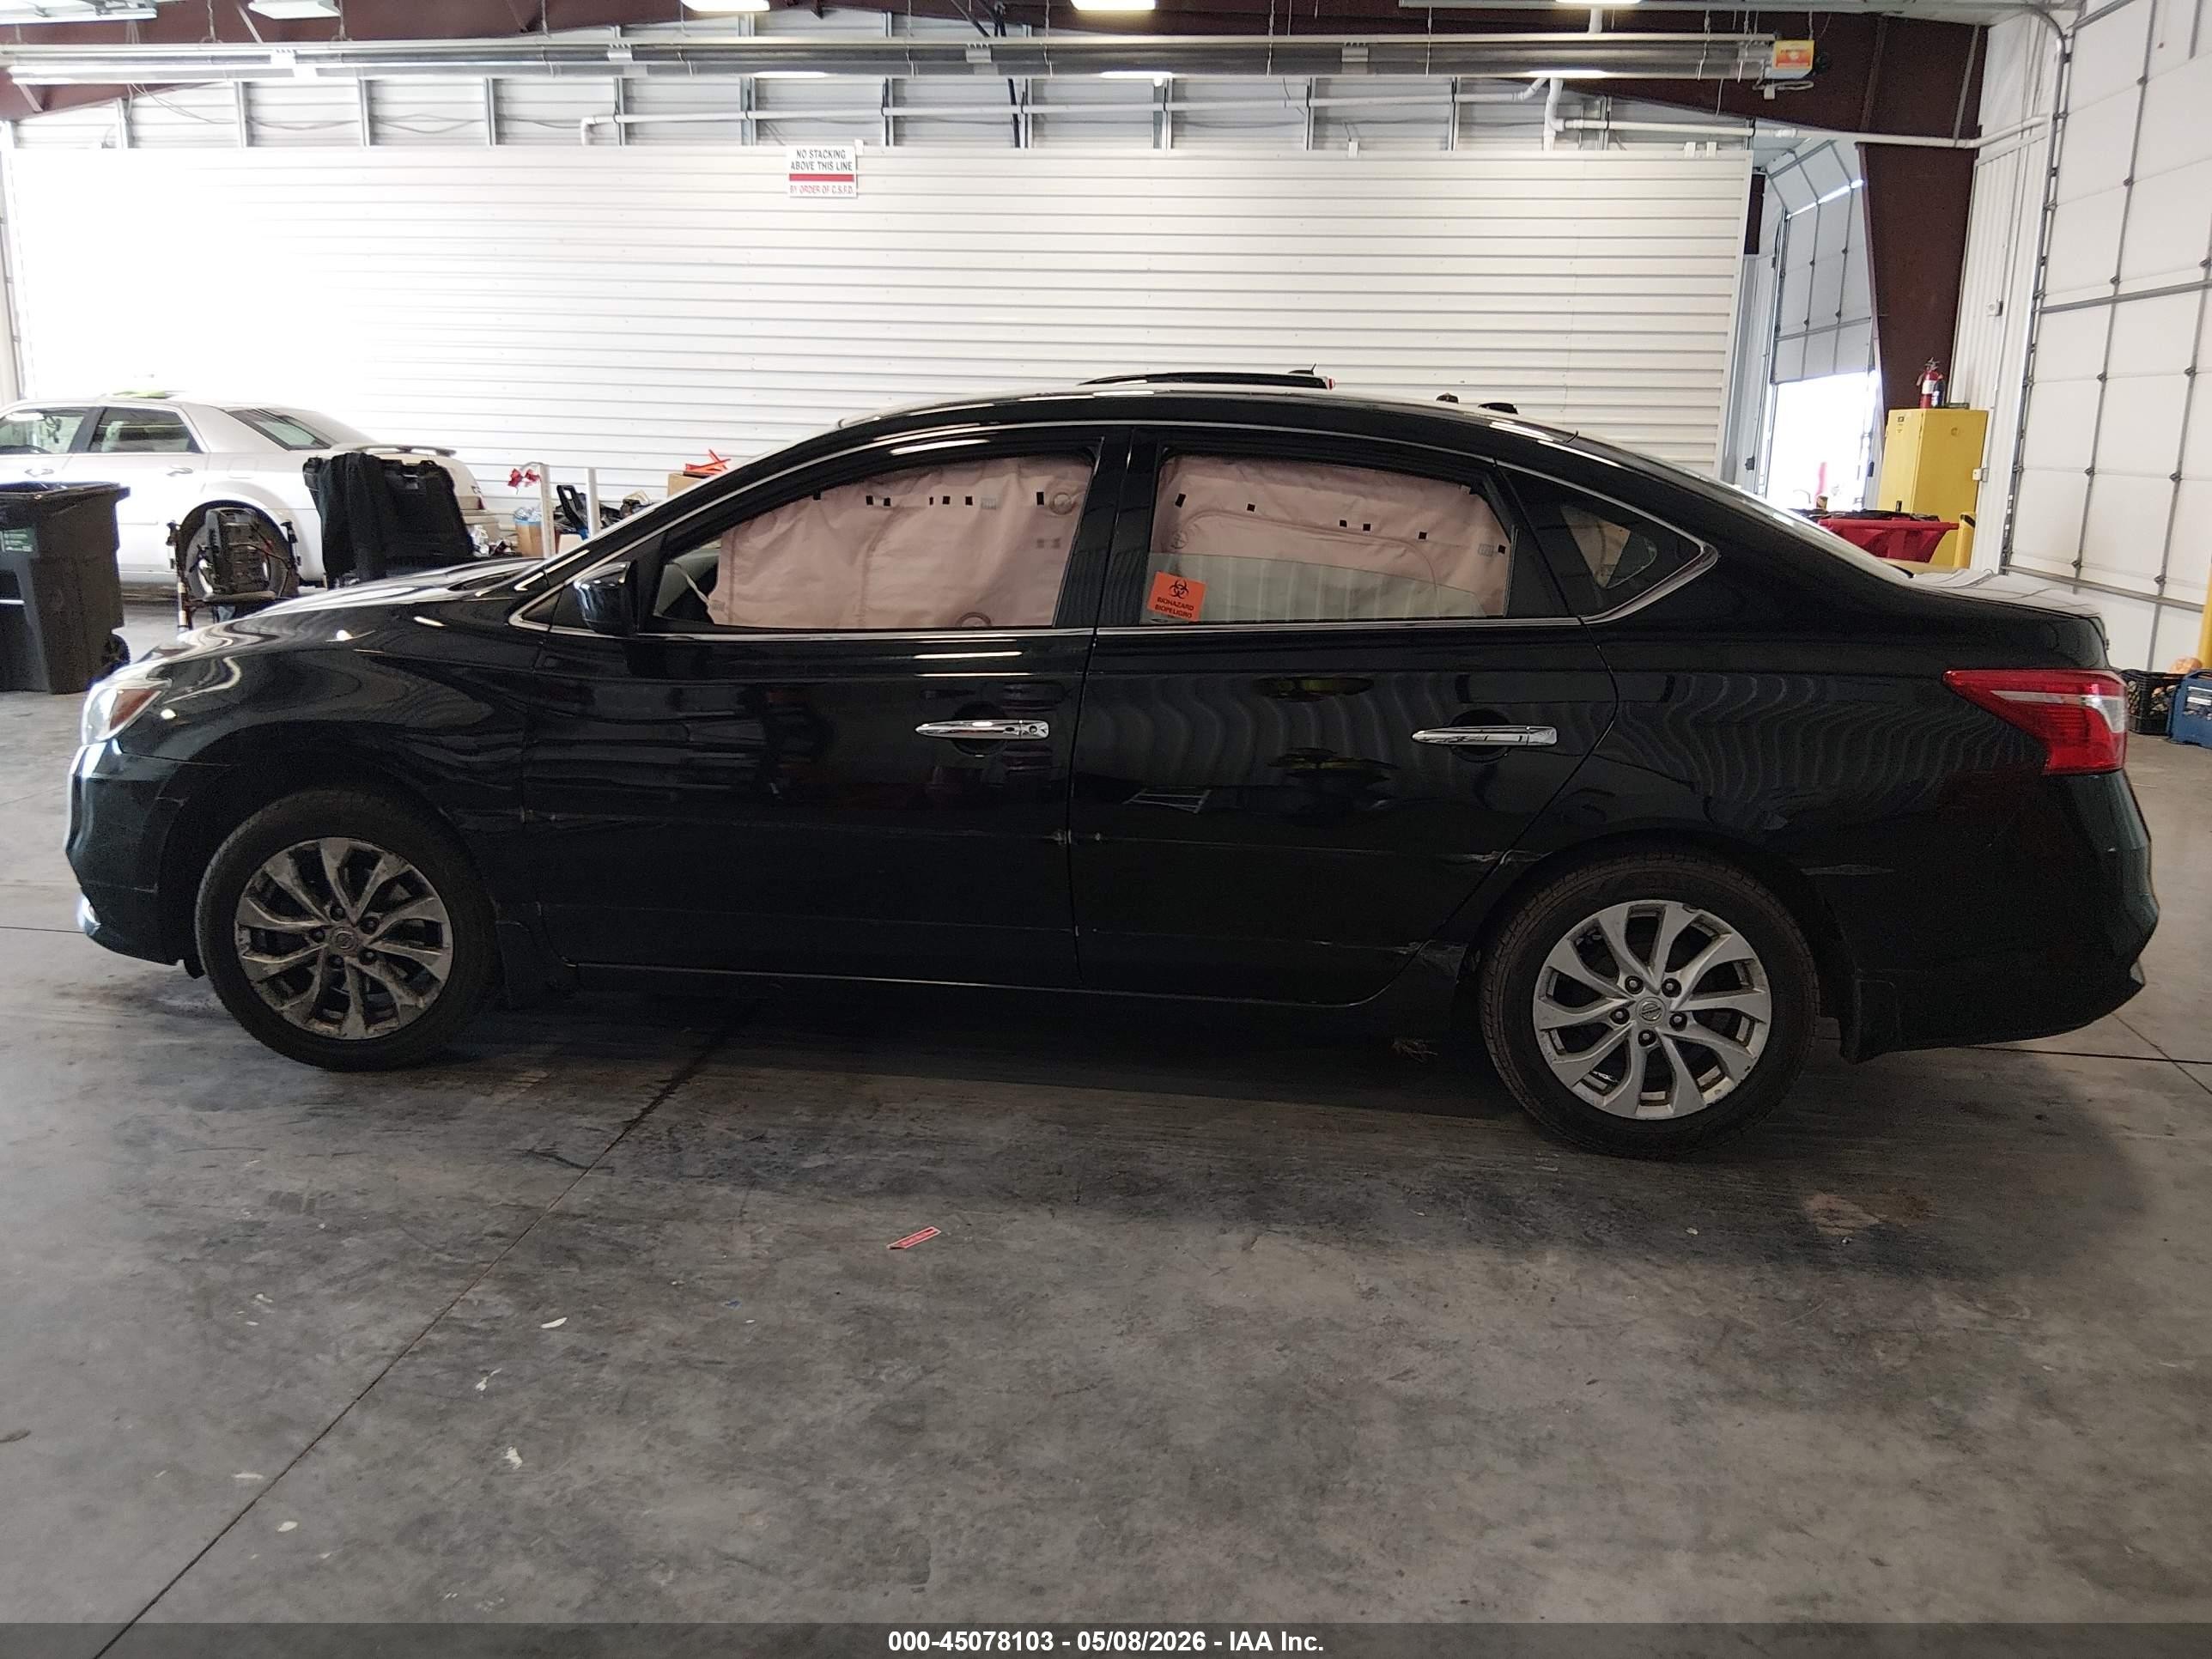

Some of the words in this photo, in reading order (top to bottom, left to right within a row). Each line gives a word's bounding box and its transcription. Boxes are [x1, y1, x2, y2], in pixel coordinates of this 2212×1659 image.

[796, 149, 807, 159] NO
[809, 149, 846, 159] STACKING
[791, 161, 815, 171] ABOVE
[817, 161, 834, 171] THIS
[836, 161, 853, 171] LINE
[790, 185, 798, 193] BY
[799, 185, 820, 194] ORDER
[822, 185, 830, 194] OF
[1157, 597, 1194, 611] BIOHAZARD
[1155, 604, 1193, 618] BIOPELIGRO
